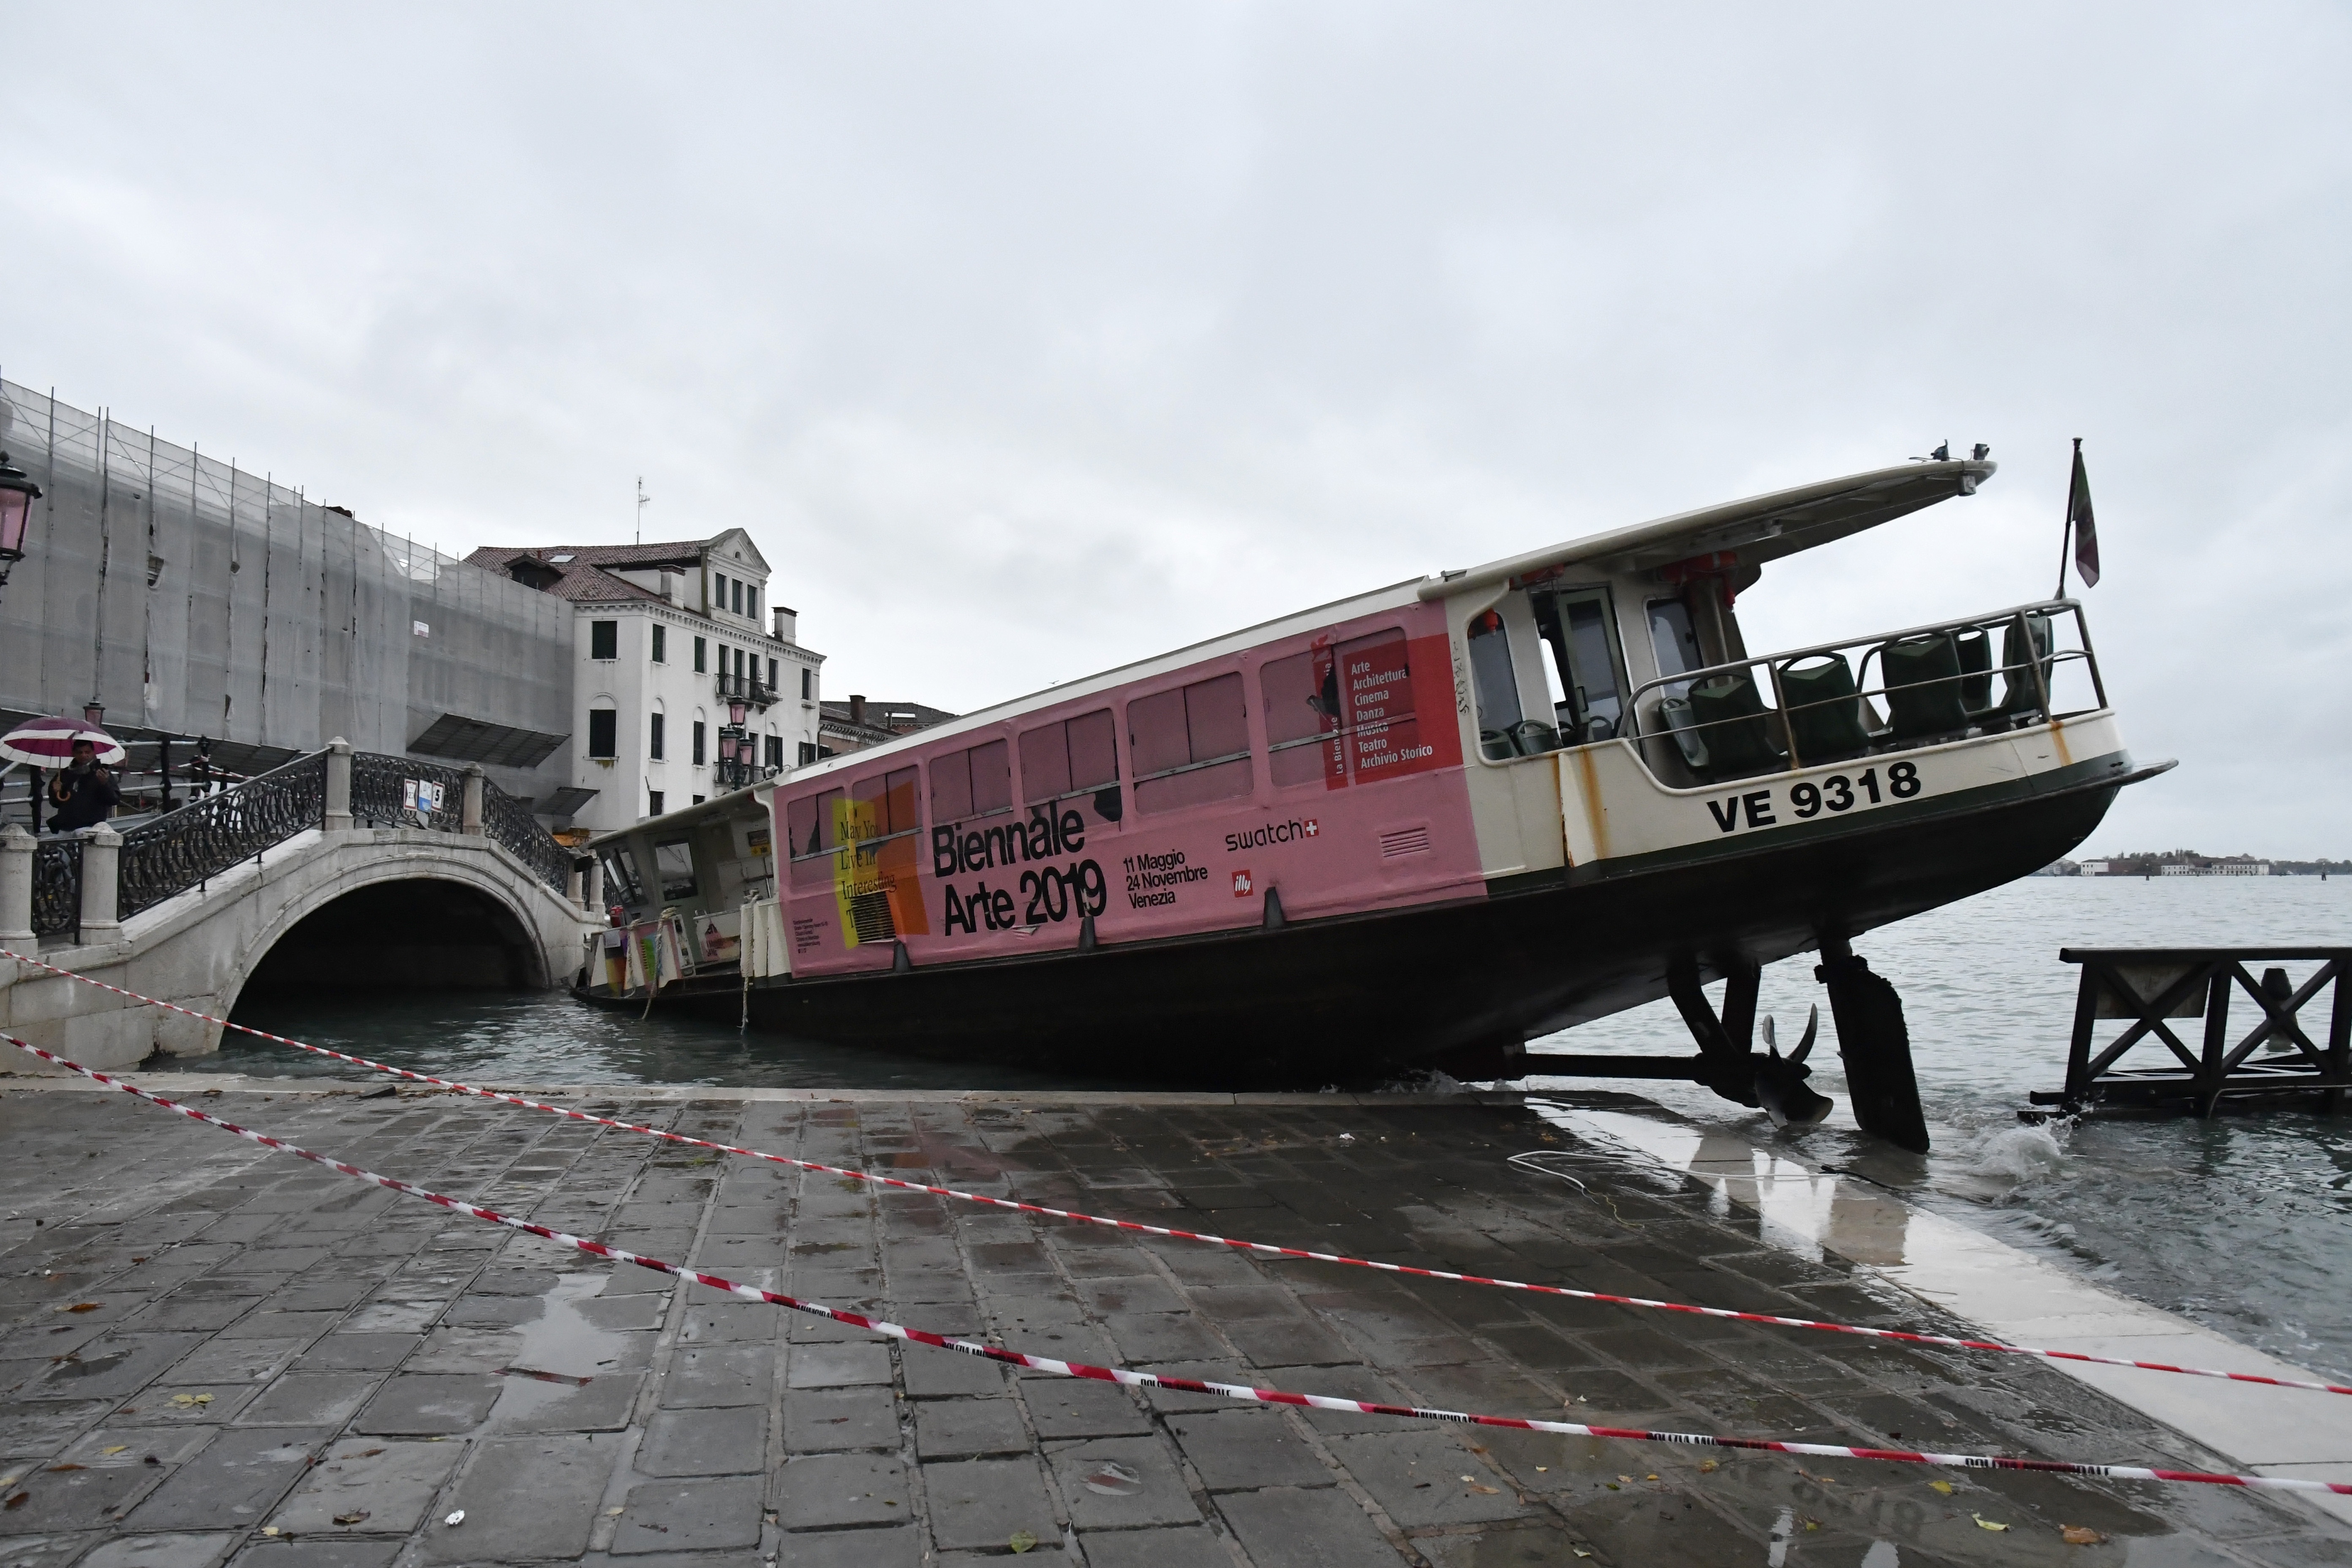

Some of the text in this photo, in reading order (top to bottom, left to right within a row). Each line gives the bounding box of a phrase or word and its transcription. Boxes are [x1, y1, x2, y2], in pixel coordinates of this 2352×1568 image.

[1351, 661, 1370, 675] Arte
[1353, 669, 1407, 691] Architettura
[1355, 689, 1389, 706] Cinema
[1356, 707, 1385, 722] Danza
[1357, 721, 1389, 738] Musica
[1358, 738, 1387, 753] Teatro
[1361, 744, 1433, 769] Archivio Storico
[1336, 763, 1343, 774] La
[435, 789, 440, 802] 5
[1706, 761, 1922, 833] VE 9318
[840, 821, 861, 841] May
[932, 799, 1085, 878] Biennale
[1225, 819, 1304, 852] swatch
[840, 848, 863, 870] Live
[1123, 849, 1186, 874] 11 Maggio
[841, 871, 897, 900] Interesting
[1126, 865, 1208, 891] 24 Novembre
[1235, 874, 1251, 895] illy
[945, 859, 1107, 936] Arte 2019
[1128, 887, 1176, 909] Venezia
